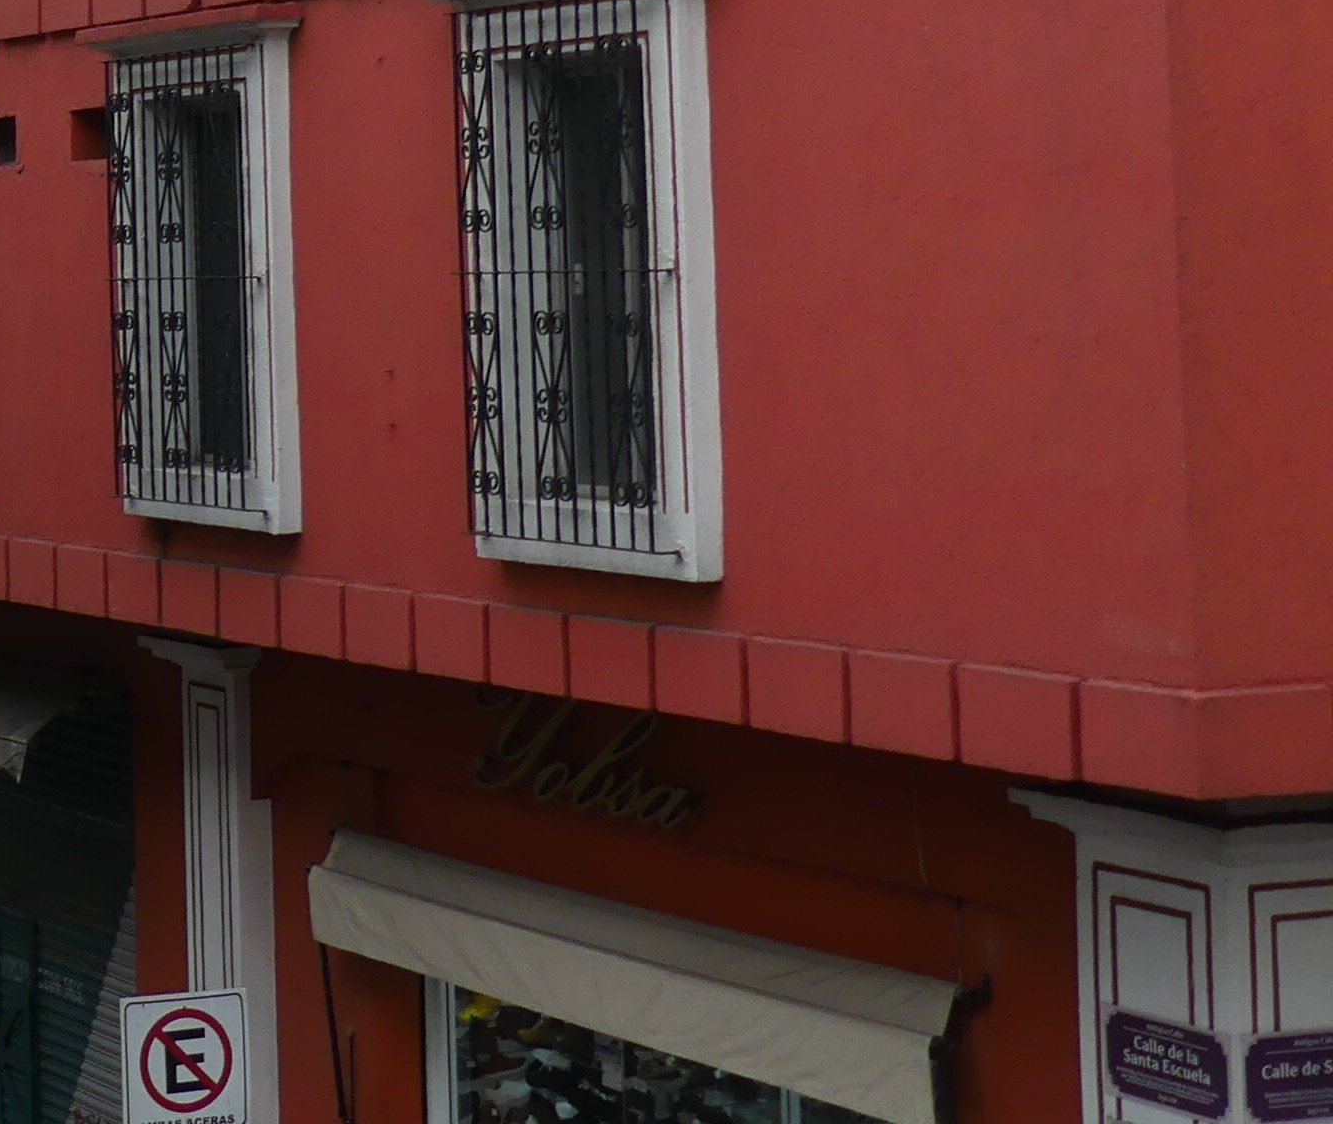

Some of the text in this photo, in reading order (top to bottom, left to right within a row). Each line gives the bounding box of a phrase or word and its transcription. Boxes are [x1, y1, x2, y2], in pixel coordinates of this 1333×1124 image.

[1133, 1035, 1200, 1066] Calle de la
[1123, 1048, 1211, 1085] Santa Escuela
[1261, 1062, 1299, 1080] Calle
[1301, 1060, 1321, 1076] de
